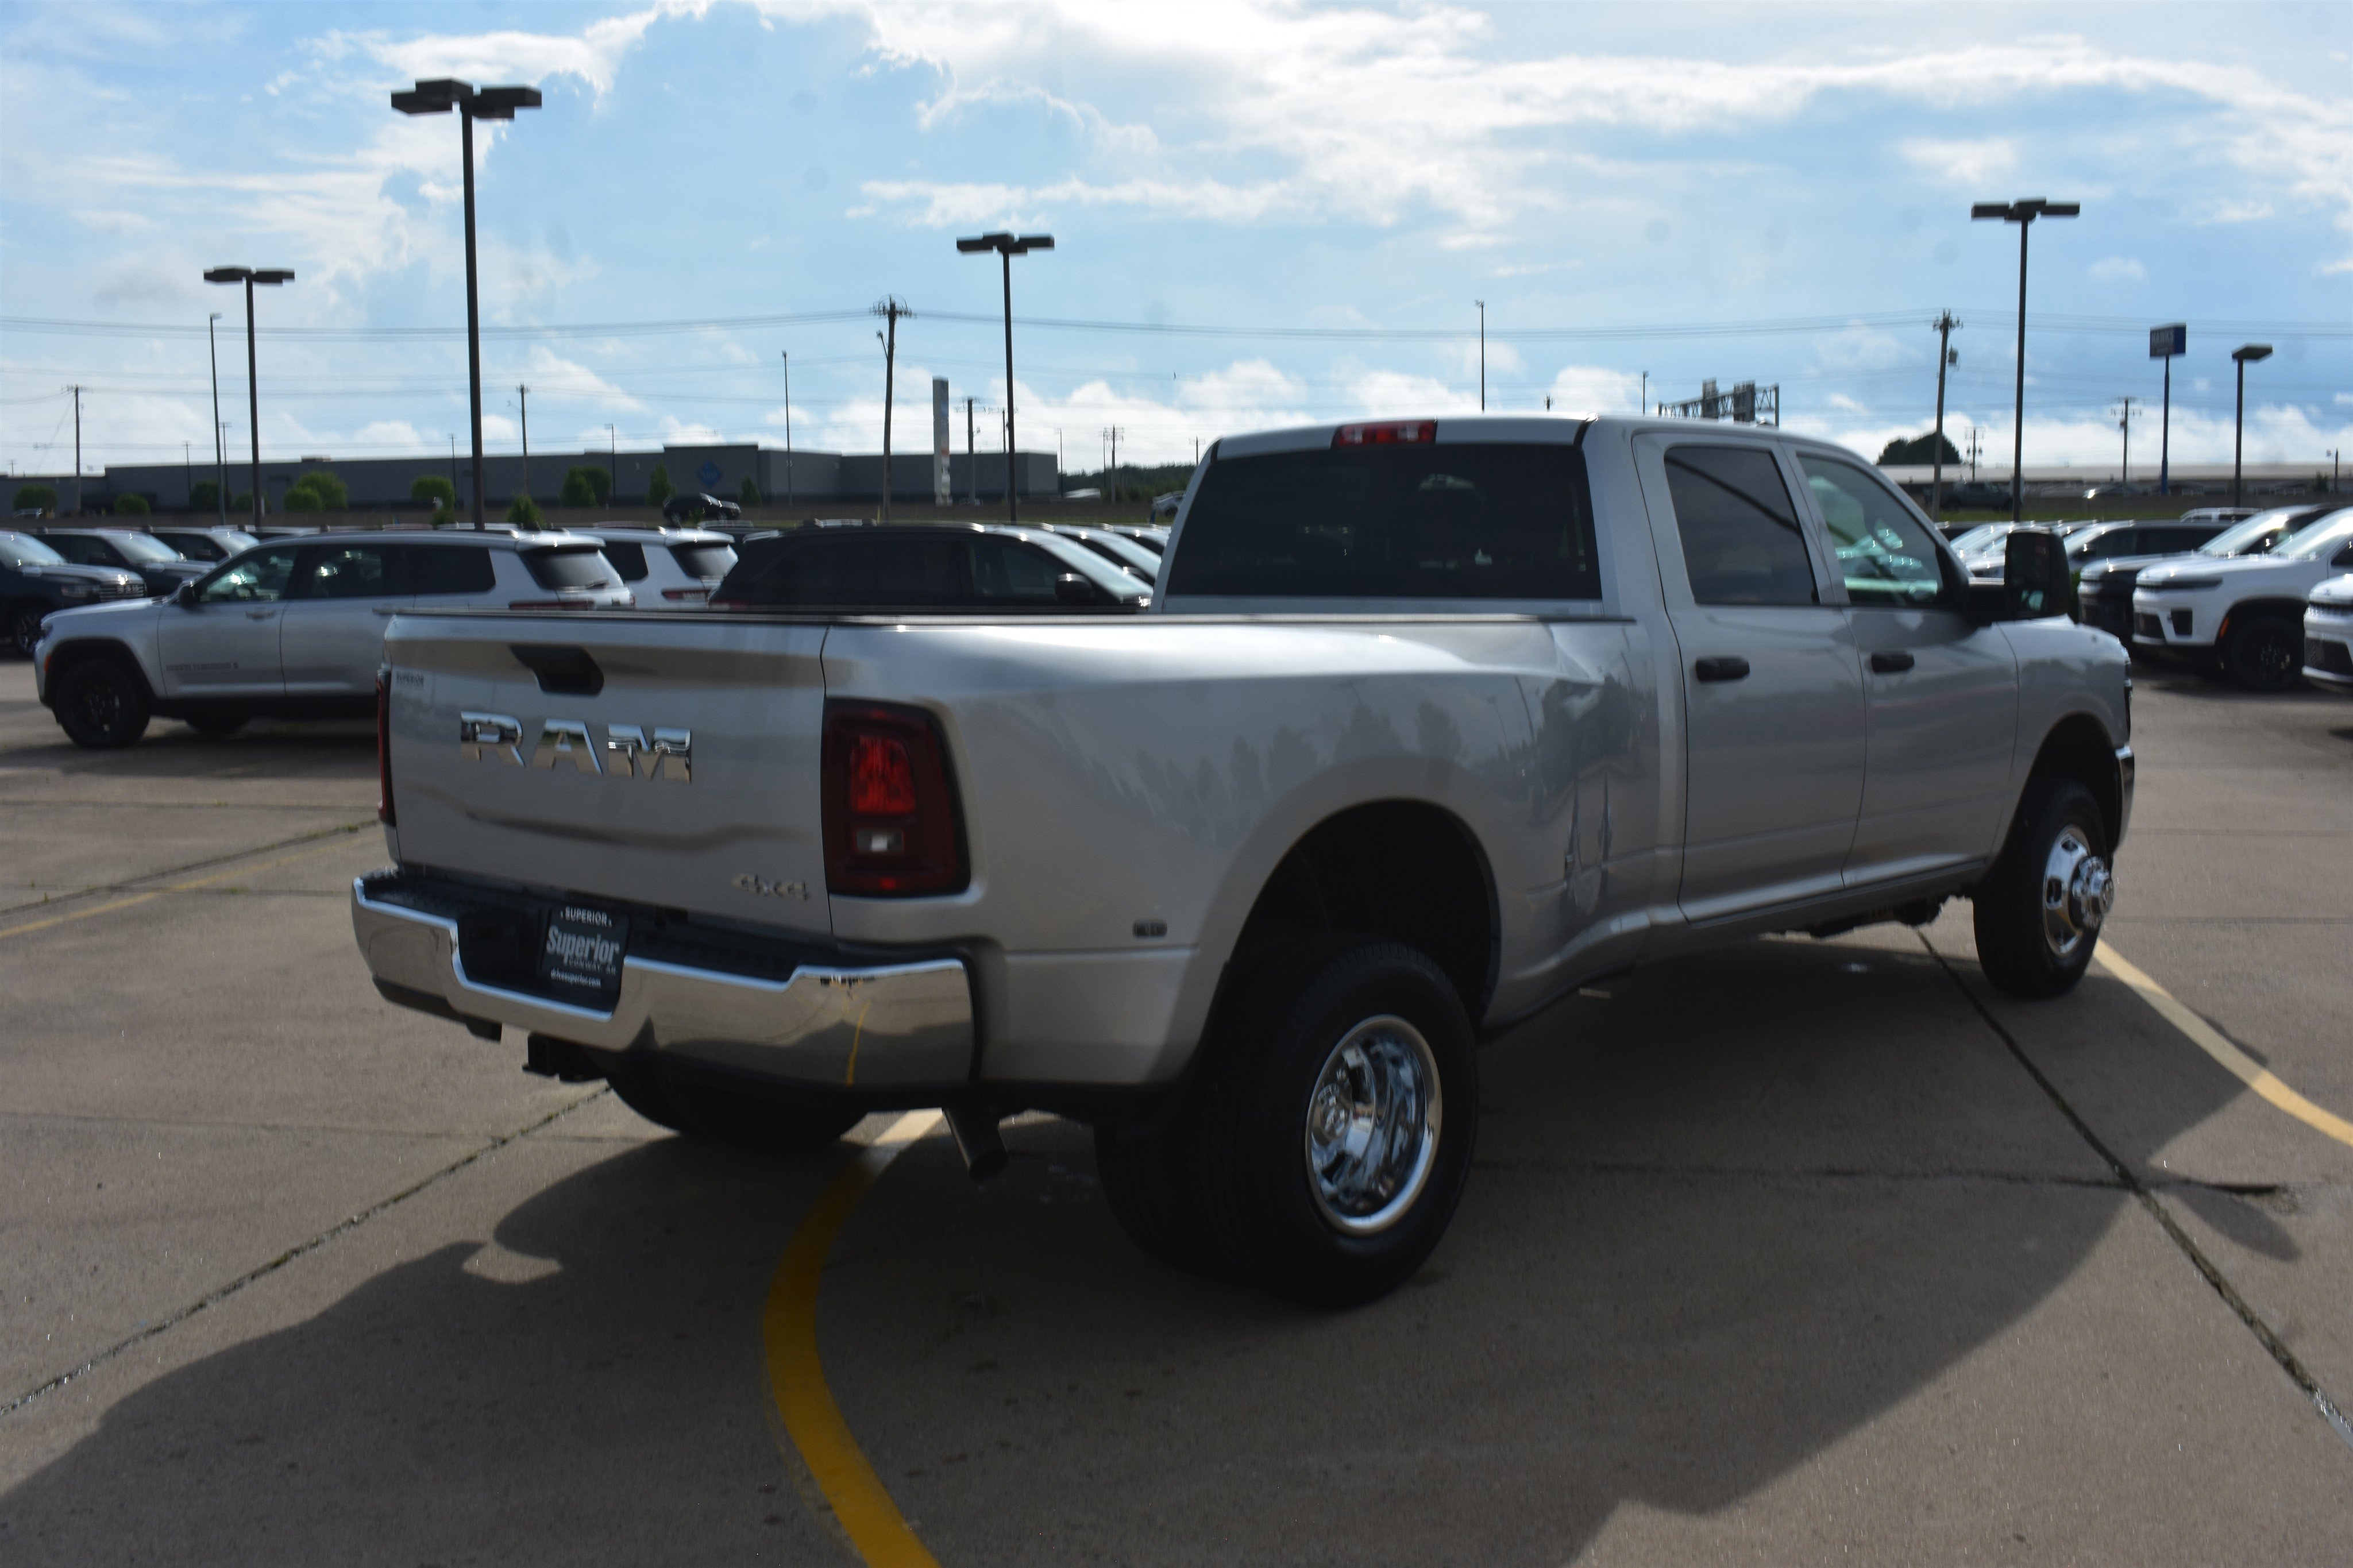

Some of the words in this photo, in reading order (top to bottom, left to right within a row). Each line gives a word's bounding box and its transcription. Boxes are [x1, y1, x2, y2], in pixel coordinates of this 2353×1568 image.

[461, 711, 692, 782] RAM
[731, 875, 809, 901] 4x4
[565, 906, 608, 927] SUPERIOR
[546, 925, 620, 967] Superior
[550, 968, 601, 989] drivesuperior.com
